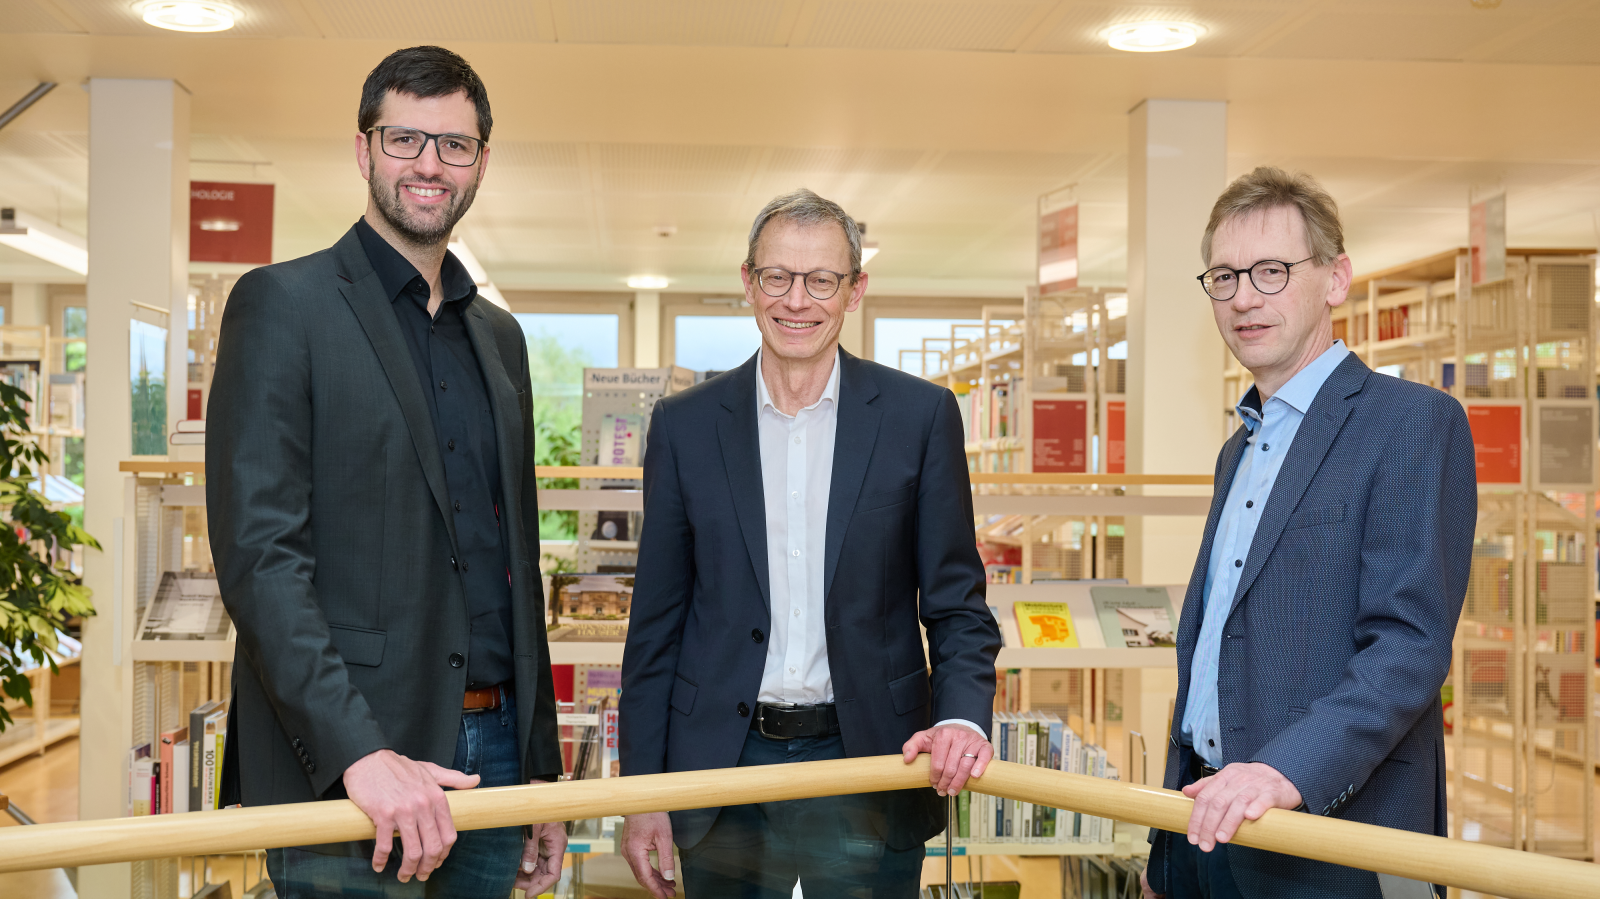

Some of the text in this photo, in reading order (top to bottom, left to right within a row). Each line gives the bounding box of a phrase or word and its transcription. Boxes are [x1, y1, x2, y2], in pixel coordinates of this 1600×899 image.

[592, 373, 620, 384] Neue
[623, 372, 662, 384] Bücher
[205, 750, 214, 766] 100
